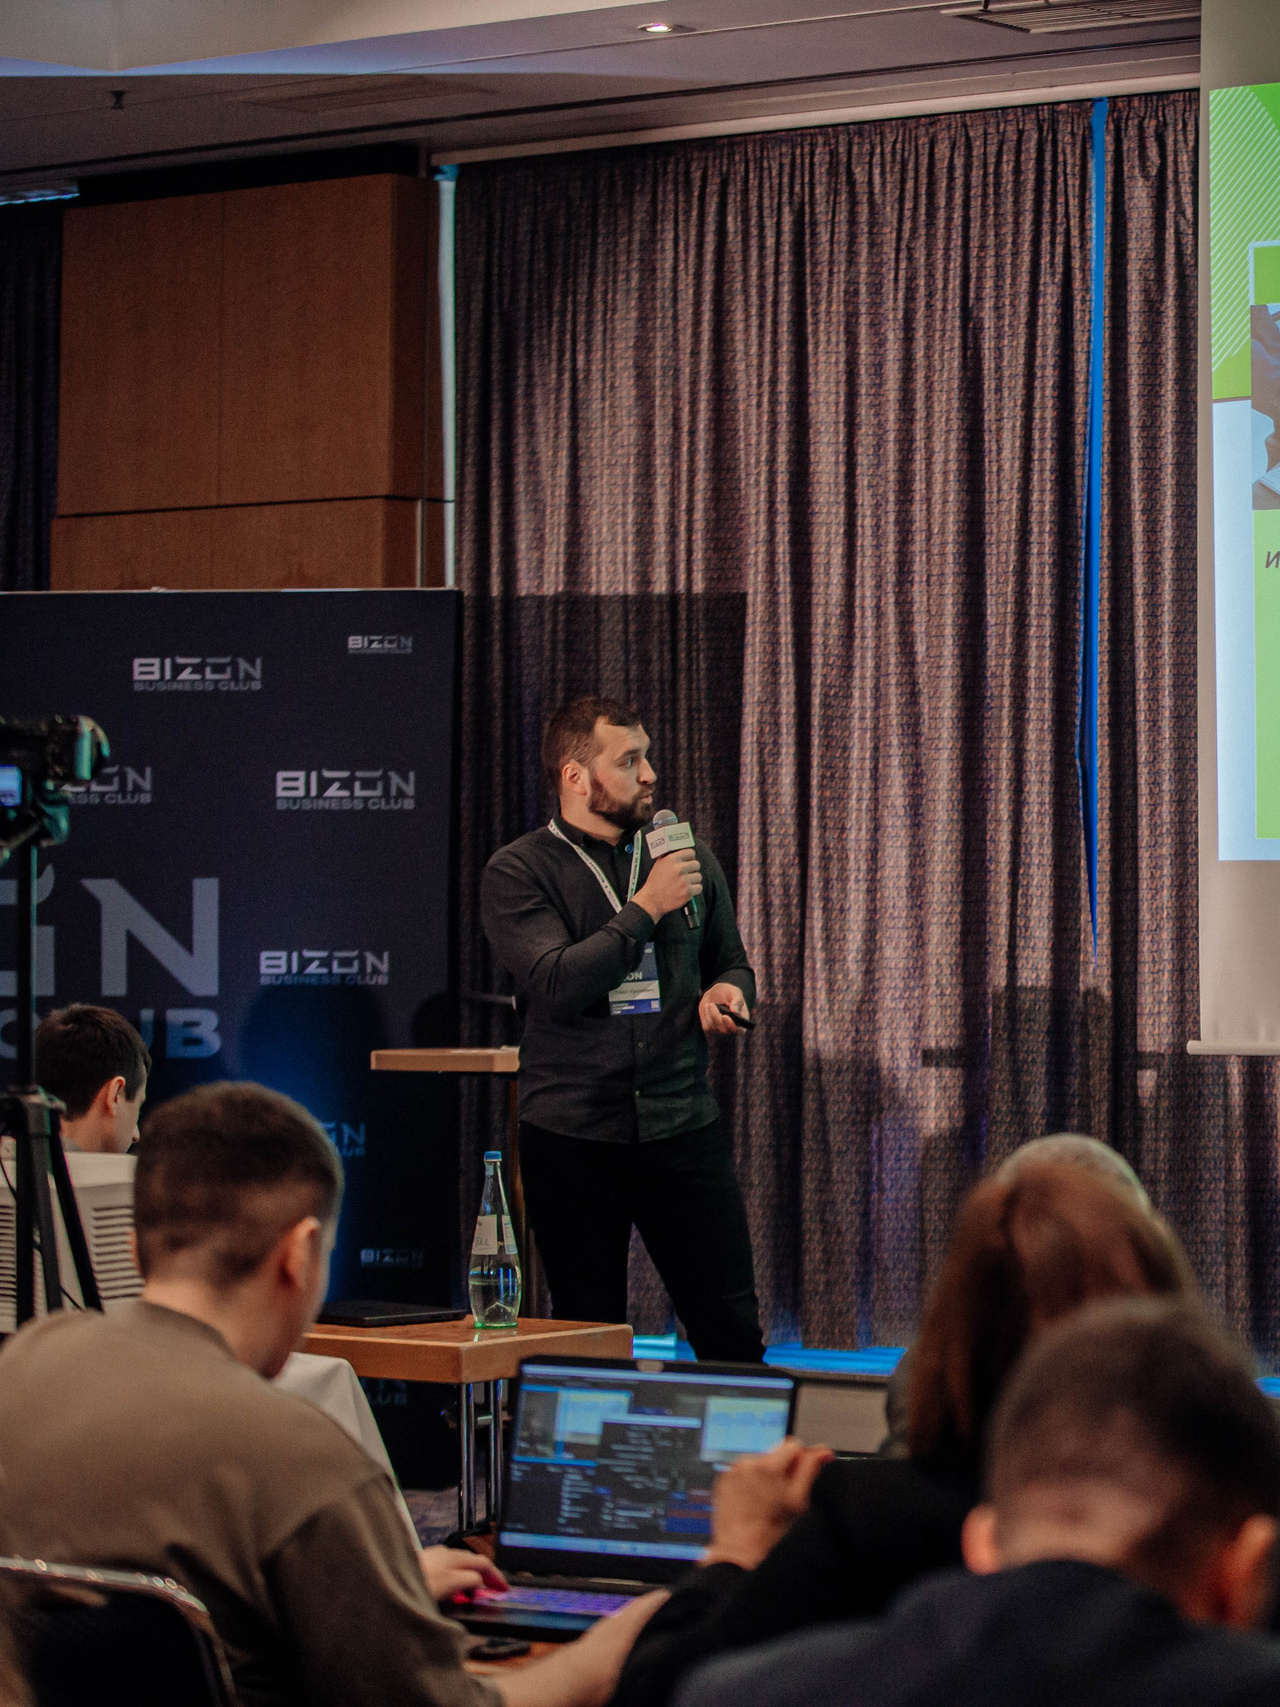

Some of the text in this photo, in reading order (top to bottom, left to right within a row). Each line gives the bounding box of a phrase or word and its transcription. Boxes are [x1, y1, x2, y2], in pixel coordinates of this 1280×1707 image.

[348, 636, 412, 648] BIZON
[133, 656, 262, 680] BIZON
[276, 768, 415, 797] BIZON
[367, 798, 415, 810] CLUB
[260, 949, 389, 974] BIZON
